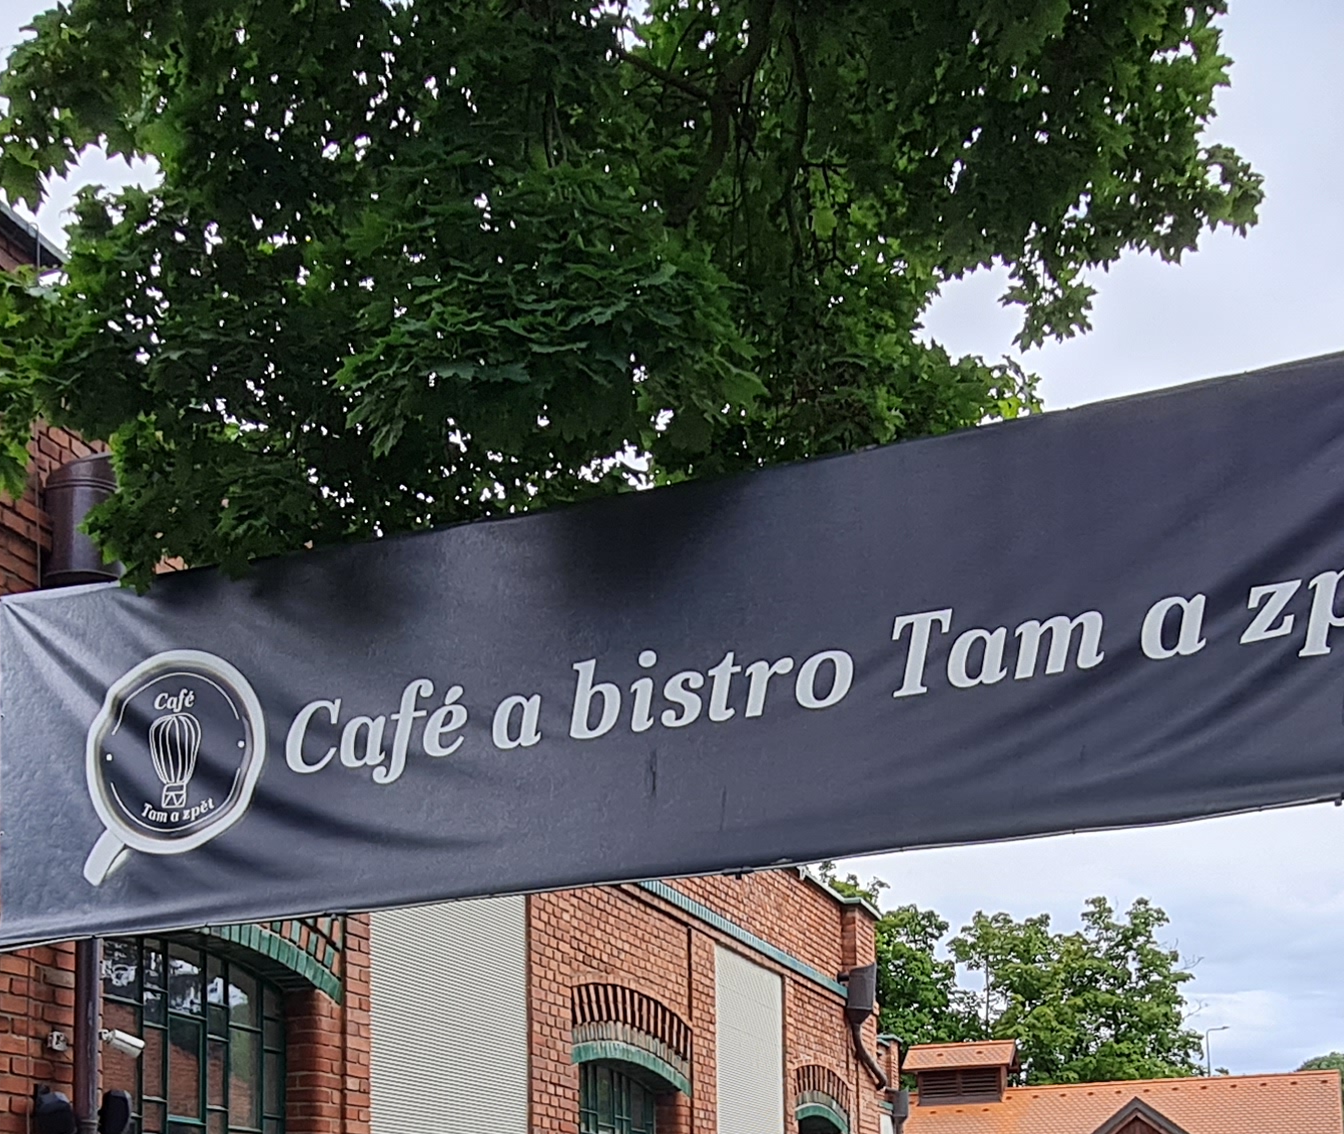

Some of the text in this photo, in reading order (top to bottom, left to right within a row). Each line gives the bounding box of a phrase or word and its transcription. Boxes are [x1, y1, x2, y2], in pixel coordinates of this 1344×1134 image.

[154, 688, 195, 713] Café
[285, 678, 467, 784] Café
[492, 694, 541, 749] a
[569, 650, 854, 739] bistro
[892, 608, 1105, 698] Tam
[1141, 593, 1207, 659] a
[141, 797, 216, 823] Tam a zpět
